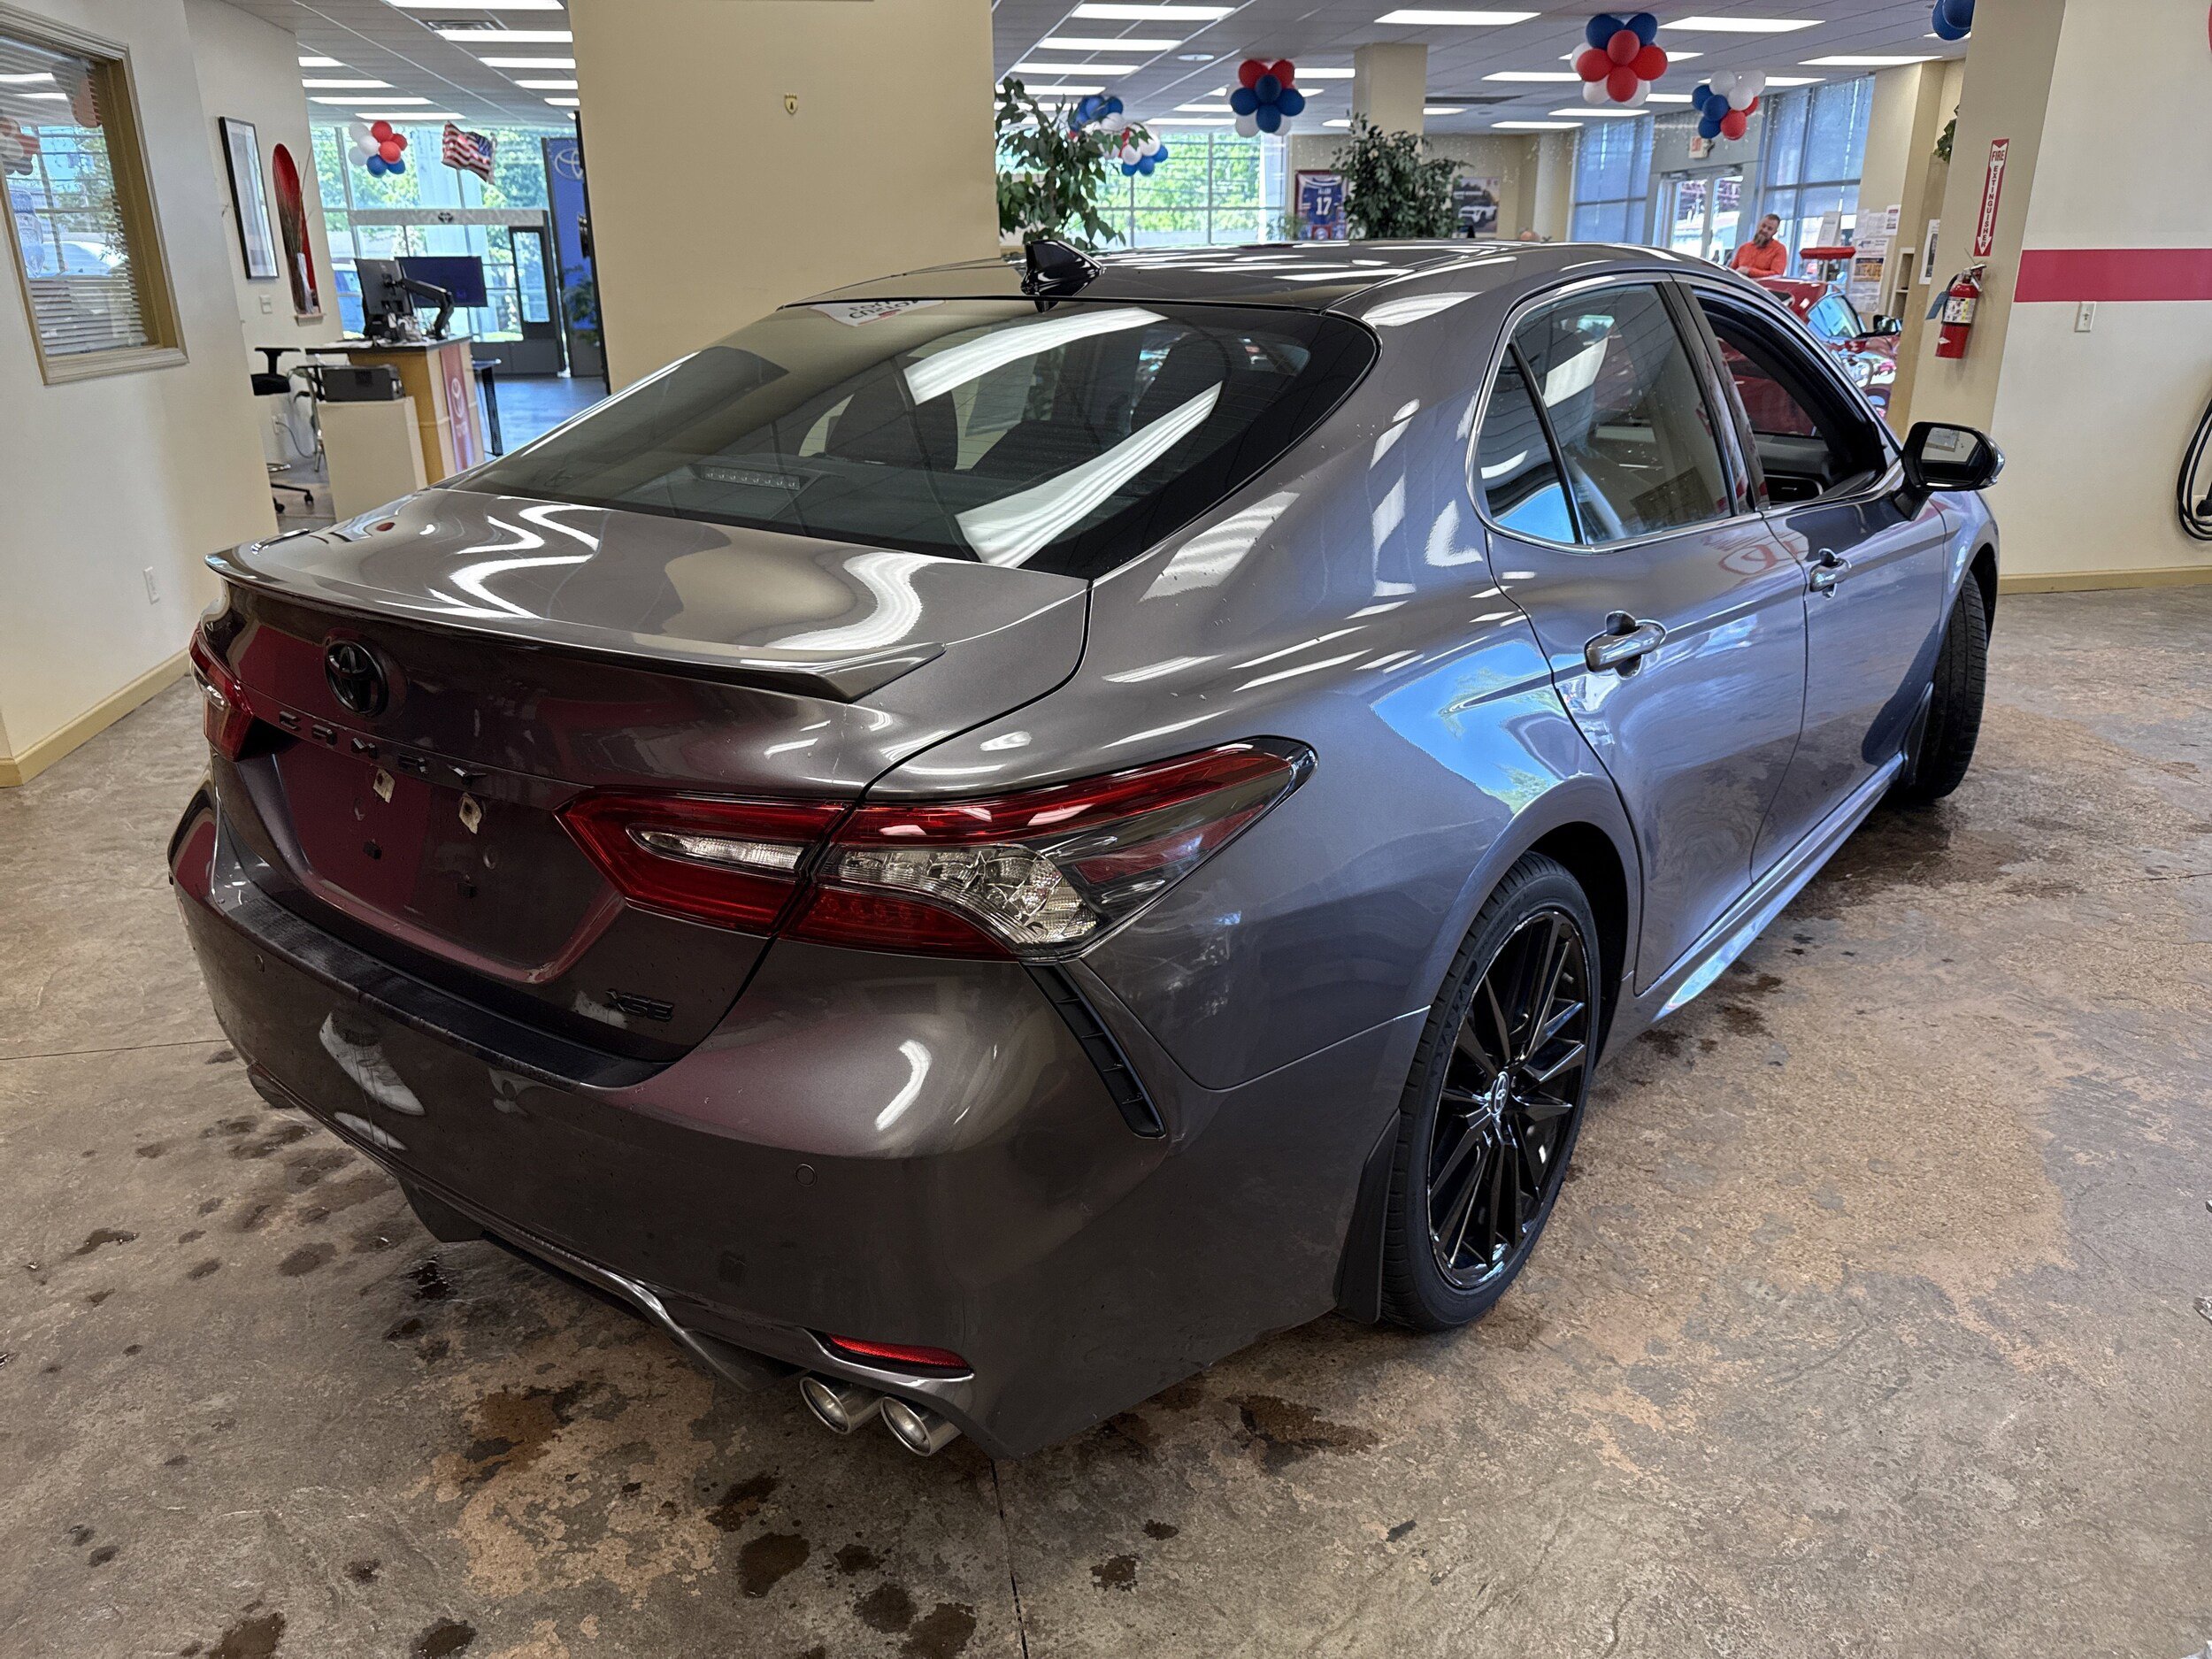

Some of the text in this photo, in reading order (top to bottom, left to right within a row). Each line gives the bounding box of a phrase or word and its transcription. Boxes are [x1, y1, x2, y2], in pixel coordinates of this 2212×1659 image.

[1992, 150, 2005, 161] FIRE
[1316, 196, 1333, 215] 17
[1981, 165, 1999, 248] EXTINGUISHER
[279, 710, 488, 786] CAMRY
[603, 988, 674, 1021] XSE
